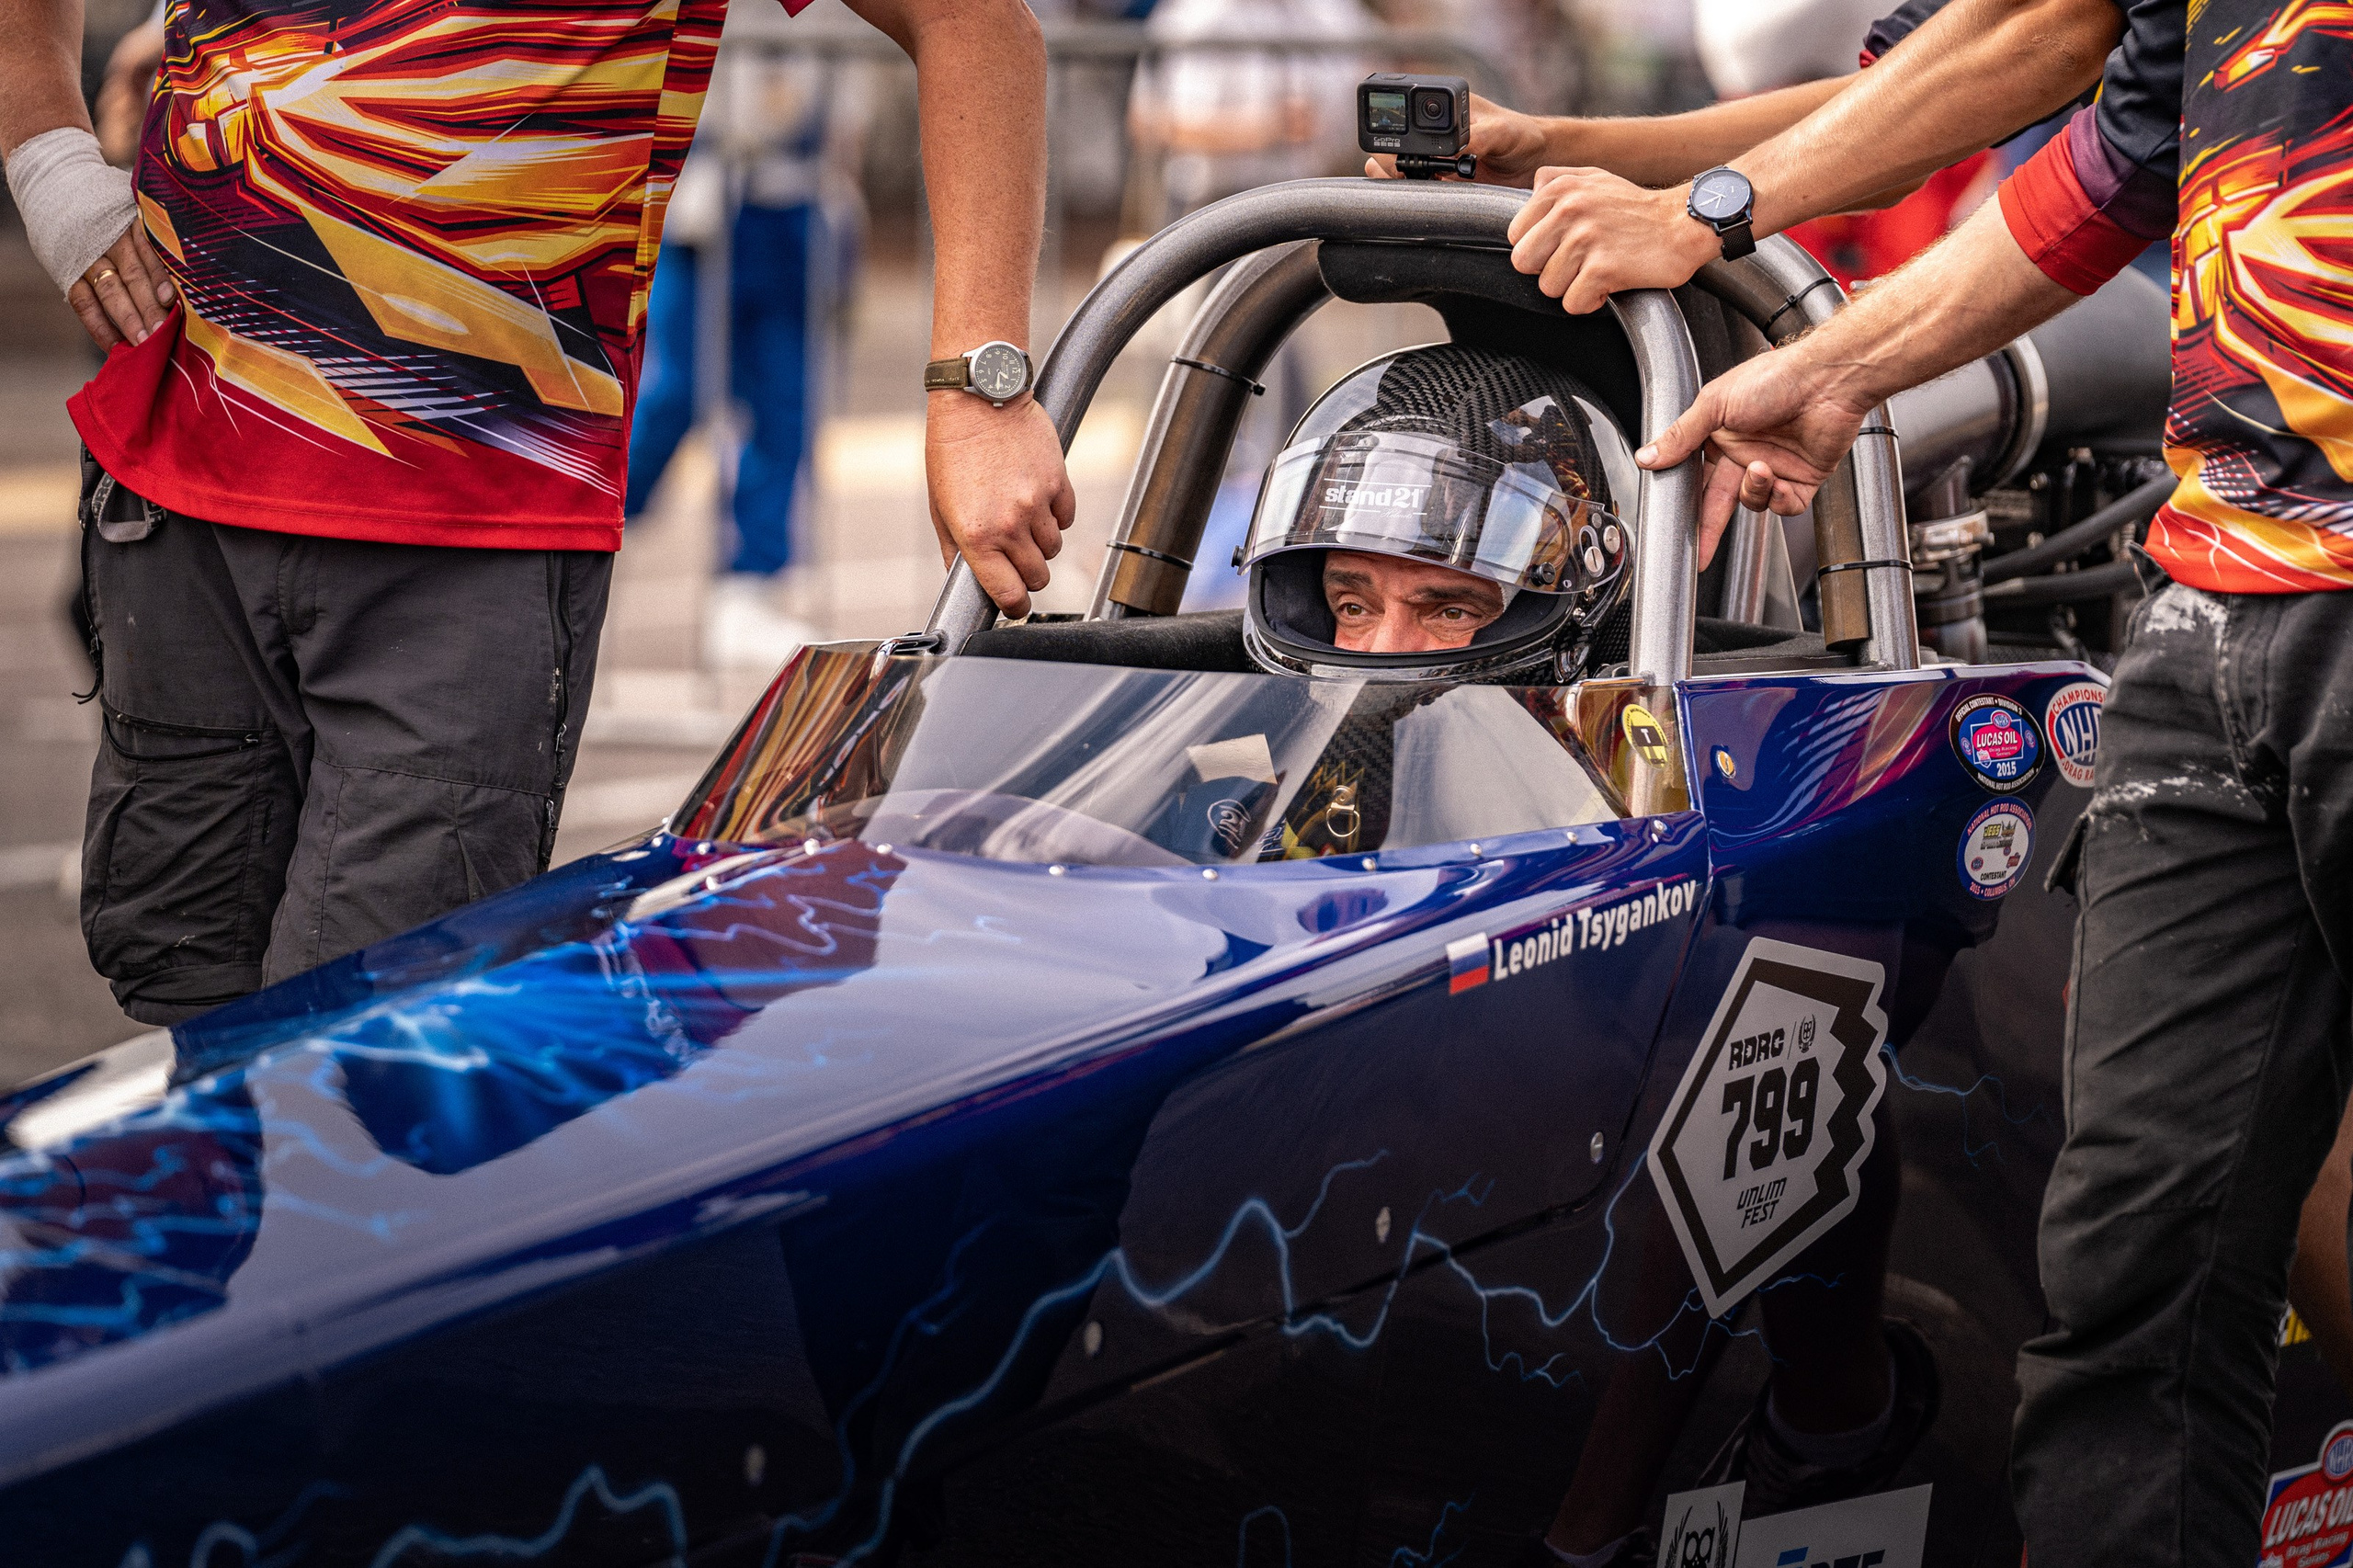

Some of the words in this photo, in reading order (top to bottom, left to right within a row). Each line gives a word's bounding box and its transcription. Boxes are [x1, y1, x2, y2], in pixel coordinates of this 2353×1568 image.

[1969, 698, 1995, 710] CONTESTANT
[1977, 732, 2003, 747] LUCAS
[2005, 731, 2018, 744] OIL
[1978, 772, 1995, 790] NATIONAL
[2011, 767, 2034, 789] ASSOCIATION
[1996, 761, 2017, 778] 2015
[2064, 761, 2083, 780] DRAG
[1968, 809, 1990, 835] NATIONAL
[1991, 804, 2000, 815] HOT
[2000, 803, 2009, 812] ROD
[2009, 804, 2033, 832] ASSOCIATION
[1970, 882, 1981, 895] 2015
[1981, 870, 2006, 881] CONTESTANT
[1495, 914, 1574, 981] Leonid
[1577, 881, 1696, 951] Tsygankov
[1729, 1028, 1785, 1071] RDRC
[1721, 1057, 1821, 1181] 799
[1737, 1177, 1787, 1210] UNLIM
[1741, 1199, 1779, 1229] FEST
[2265, 1490, 2333, 1549] LUCAS
